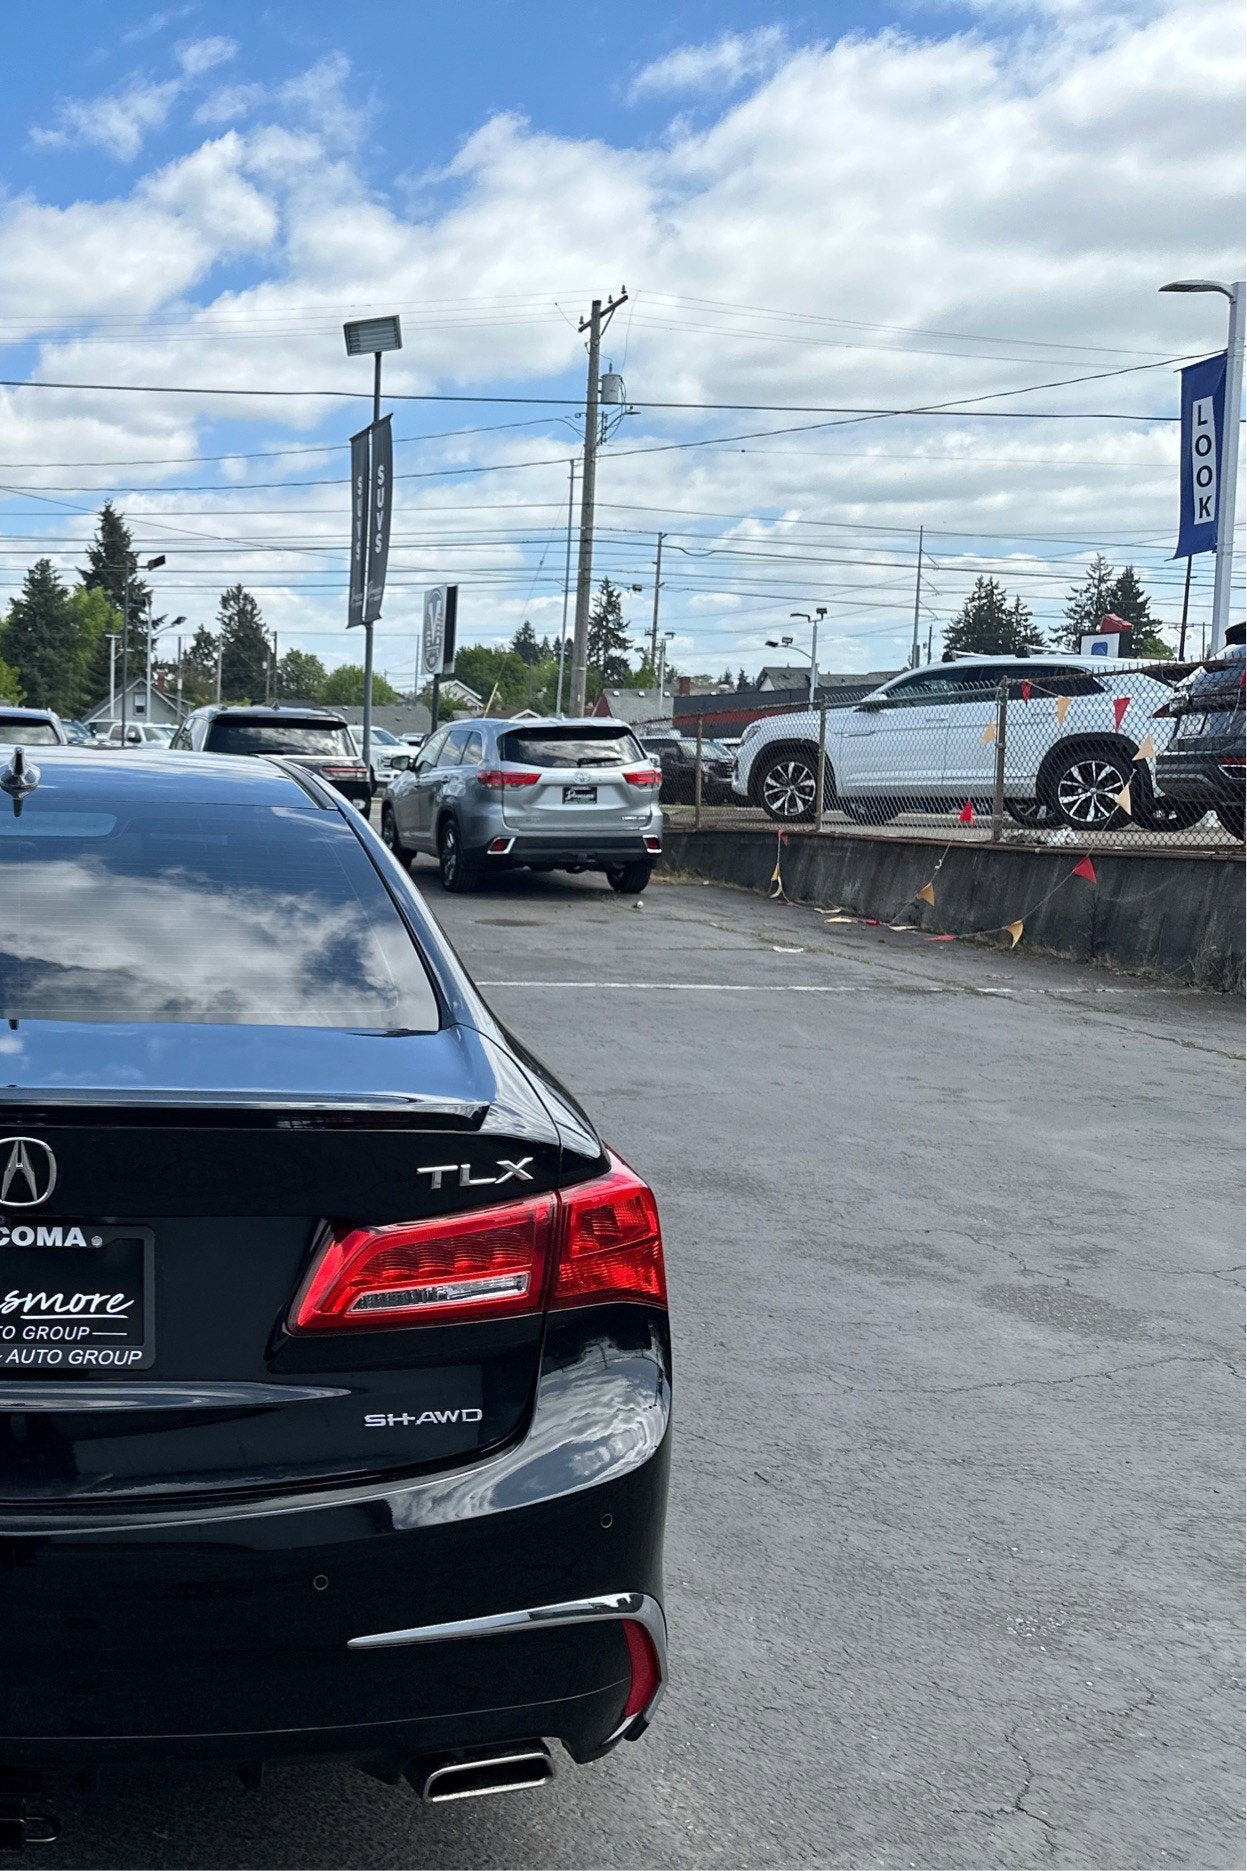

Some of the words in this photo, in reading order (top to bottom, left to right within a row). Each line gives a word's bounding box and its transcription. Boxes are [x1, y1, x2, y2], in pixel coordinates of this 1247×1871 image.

[1194, 404, 1213, 519] LOOK
[374, 464, 385, 554] SUVS
[416, 1156, 534, 1190] TLX
[22, 1326, 90, 1341] GROUP
[5, 1348, 63, 1365] AUTO
[67, 1349, 143, 1366] GROUP
[364, 1408, 483, 1427] SH-AWD
